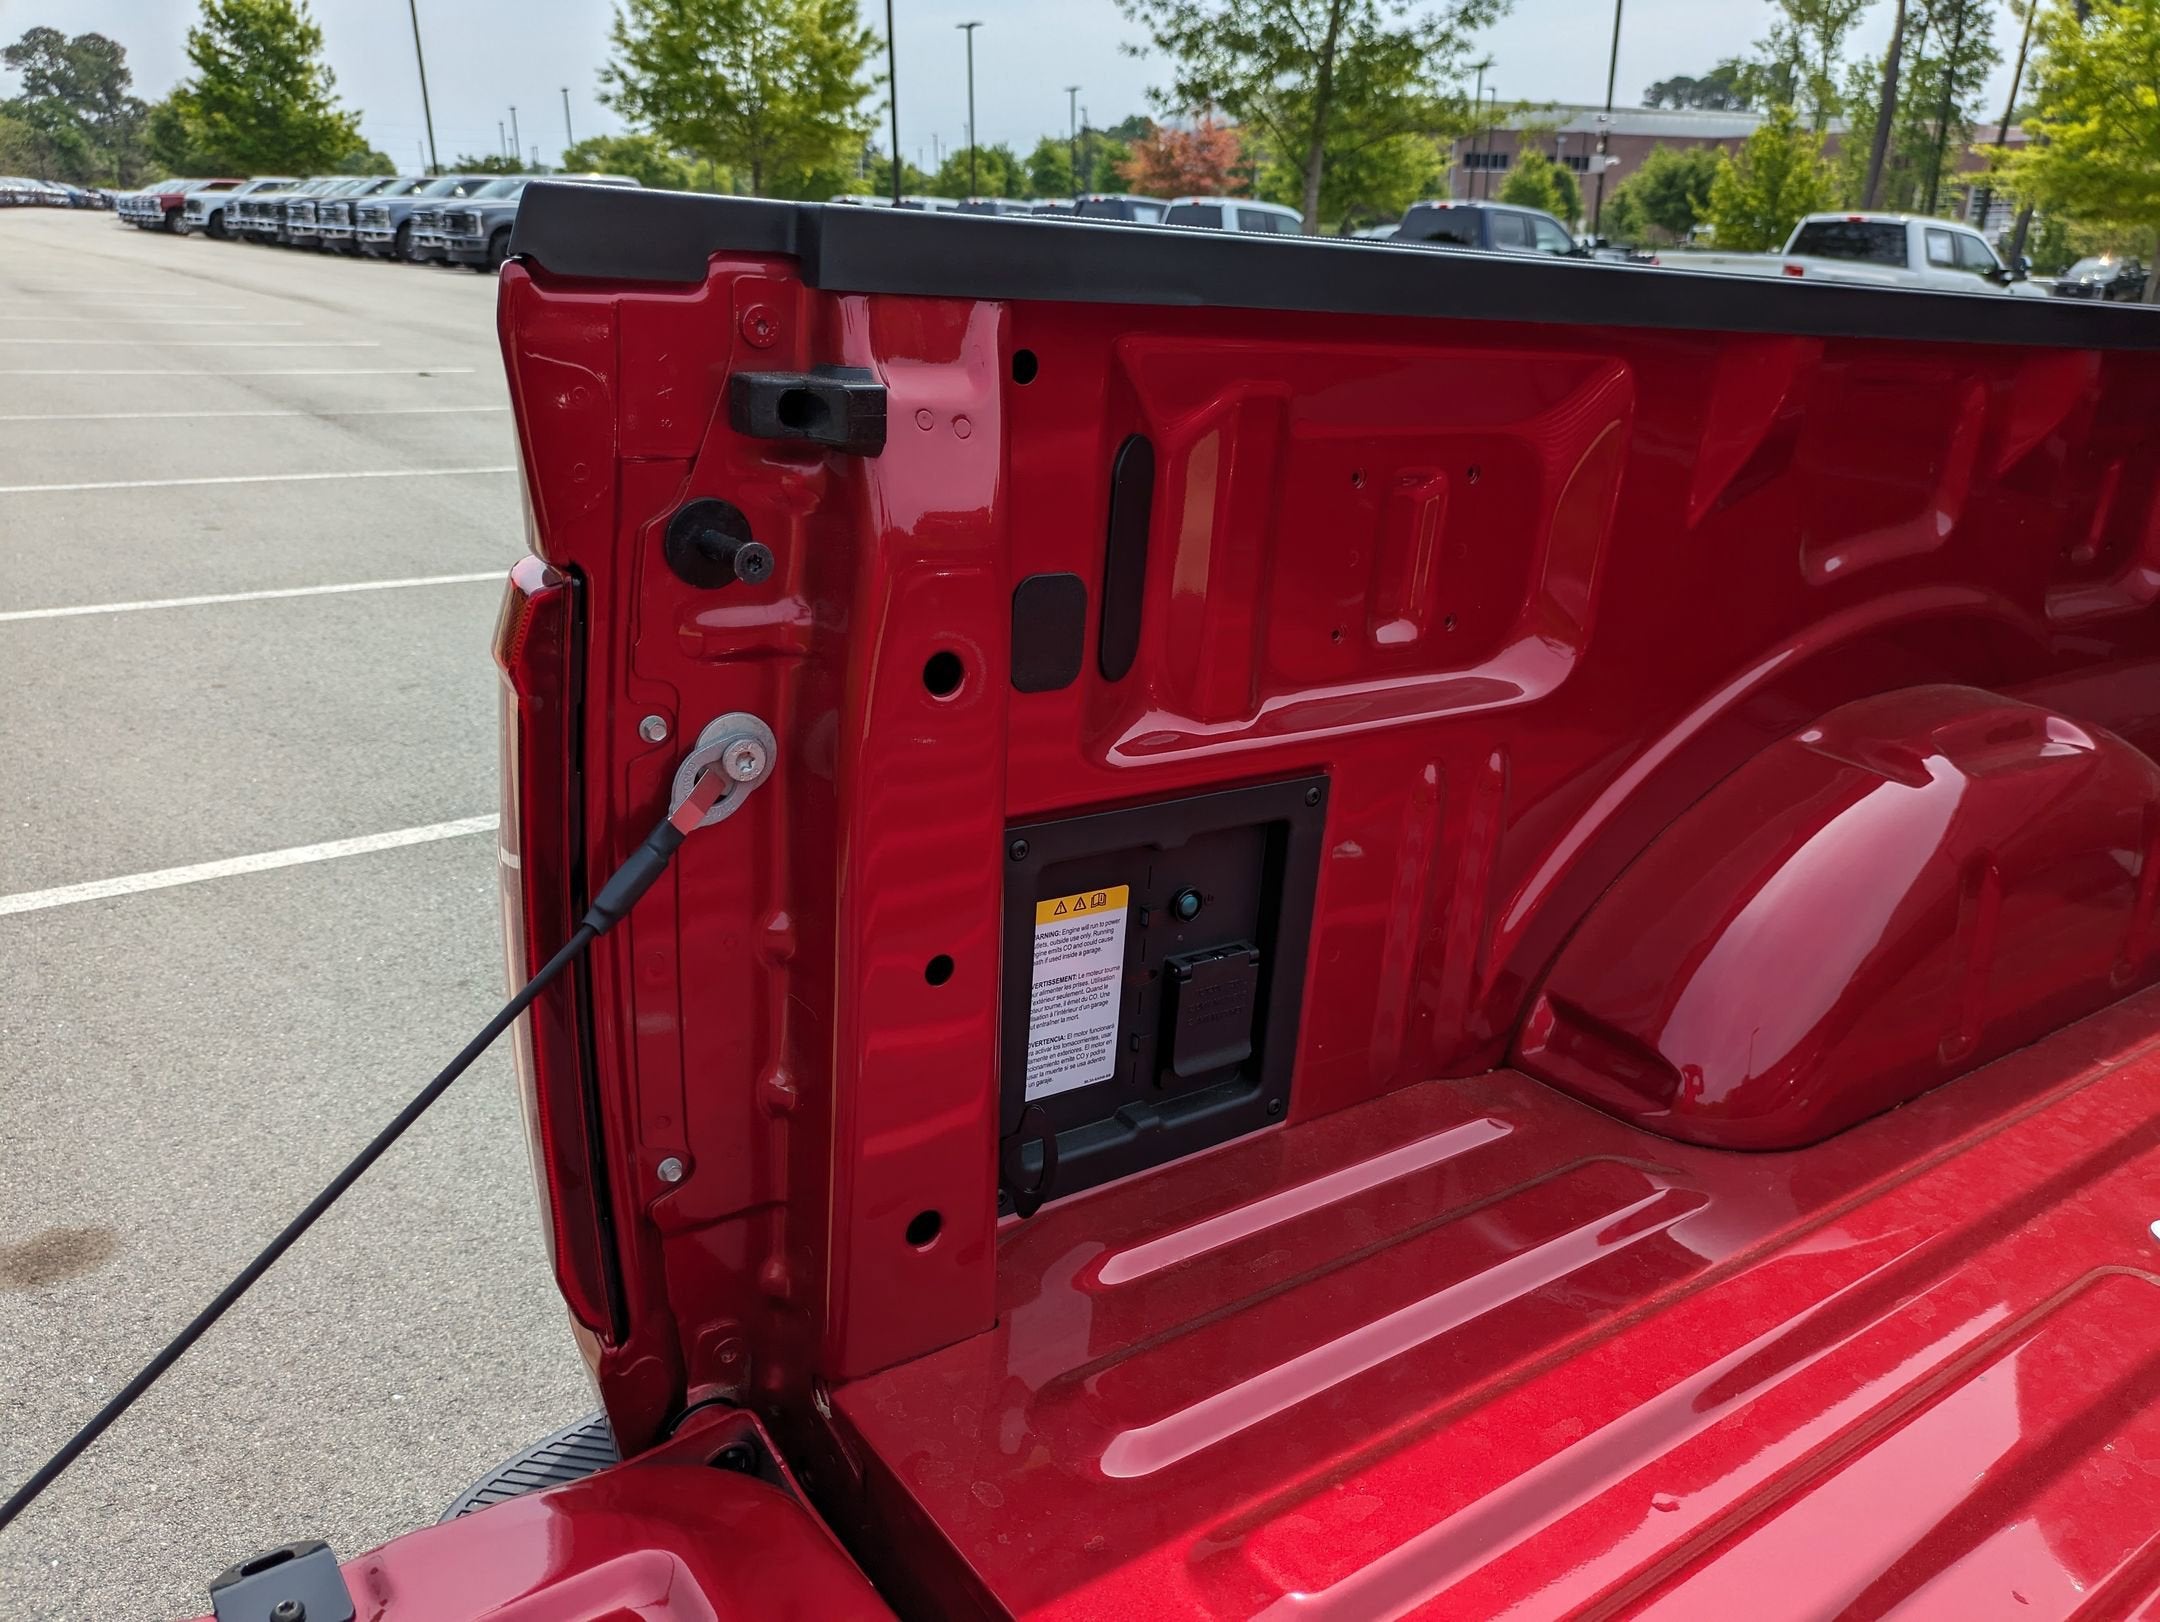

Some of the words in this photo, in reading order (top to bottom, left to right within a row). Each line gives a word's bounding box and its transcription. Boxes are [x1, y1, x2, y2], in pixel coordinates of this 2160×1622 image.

[1034, 930, 1060, 942] ARNING:
[1062, 927, 1080, 935] Engine
[1104, 919, 1120, 927] power
[1049, 937, 1069, 946] outside
[1070, 934, 1079, 942] use
[1092, 928, 1114, 936] Running
[1047, 947, 1062, 955] emits
[1062, 944, 1072, 952] CO
[1083, 938, 1097, 947] could
[1098, 935, 1113, 944] cause
[1049, 954, 1061, 963] used
[1083, 947, 1102, 957] garage.
[1085, 969, 1103, 977] moteur
[1104, 965, 1120, 973] tourne
[1038, 986, 1063, 996] alimenter
[1090, 975, 1115, 984] Utilisation
[1085, 985, 1103, 993] Quand
[1066, 998, 1080, 1006] émet
[1091, 1000, 1108, 1010] garage
[1073, 1030, 1088, 1038] motor
[1091, 1041, 1105, 1049] motor
[1035, 1047, 1052, 1055] activar
[1045, 1067, 1063, 1075] muerte
[1077, 1060, 1086, 1068] usa
[1087, 1056, 1106, 1065] adentro
[1061, 1056, 1075, 1064] emite
